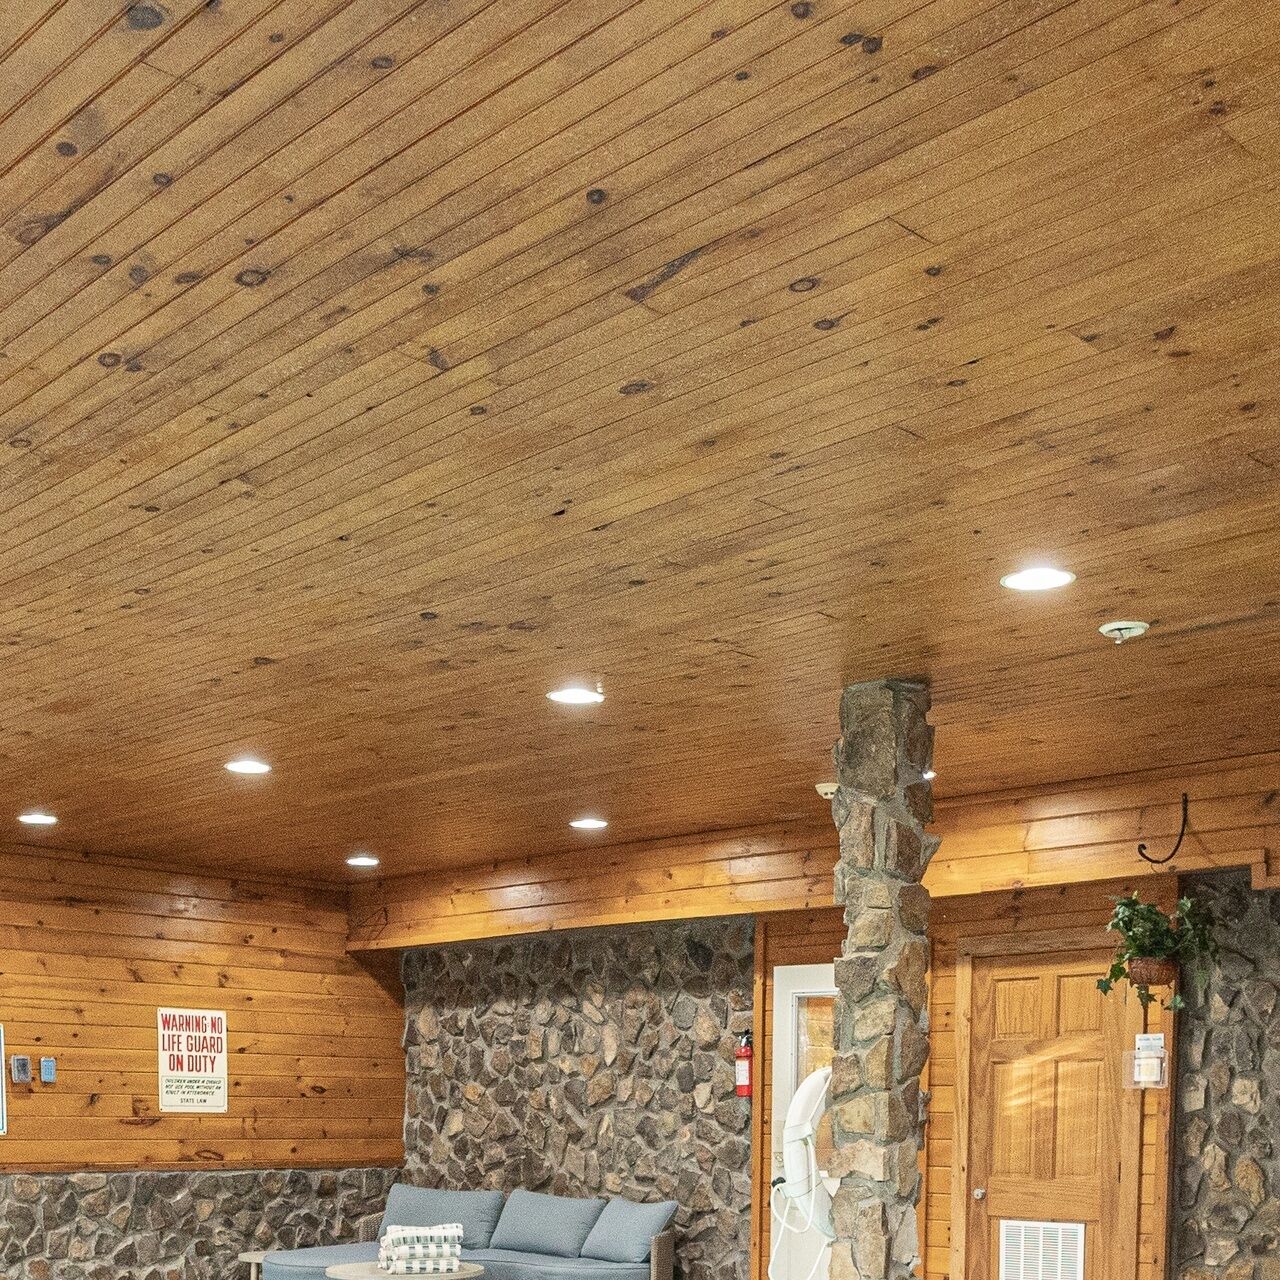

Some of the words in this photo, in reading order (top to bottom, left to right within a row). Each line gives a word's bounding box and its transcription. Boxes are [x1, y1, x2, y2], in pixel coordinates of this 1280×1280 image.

[211, 1016, 222, 1034] NO
[162, 1034, 182, 1052] LIFE
[186, 1035, 223, 1053] GUARD
[169, 1054, 183, 1071] ON
[188, 1055, 216, 1073] DUTY
